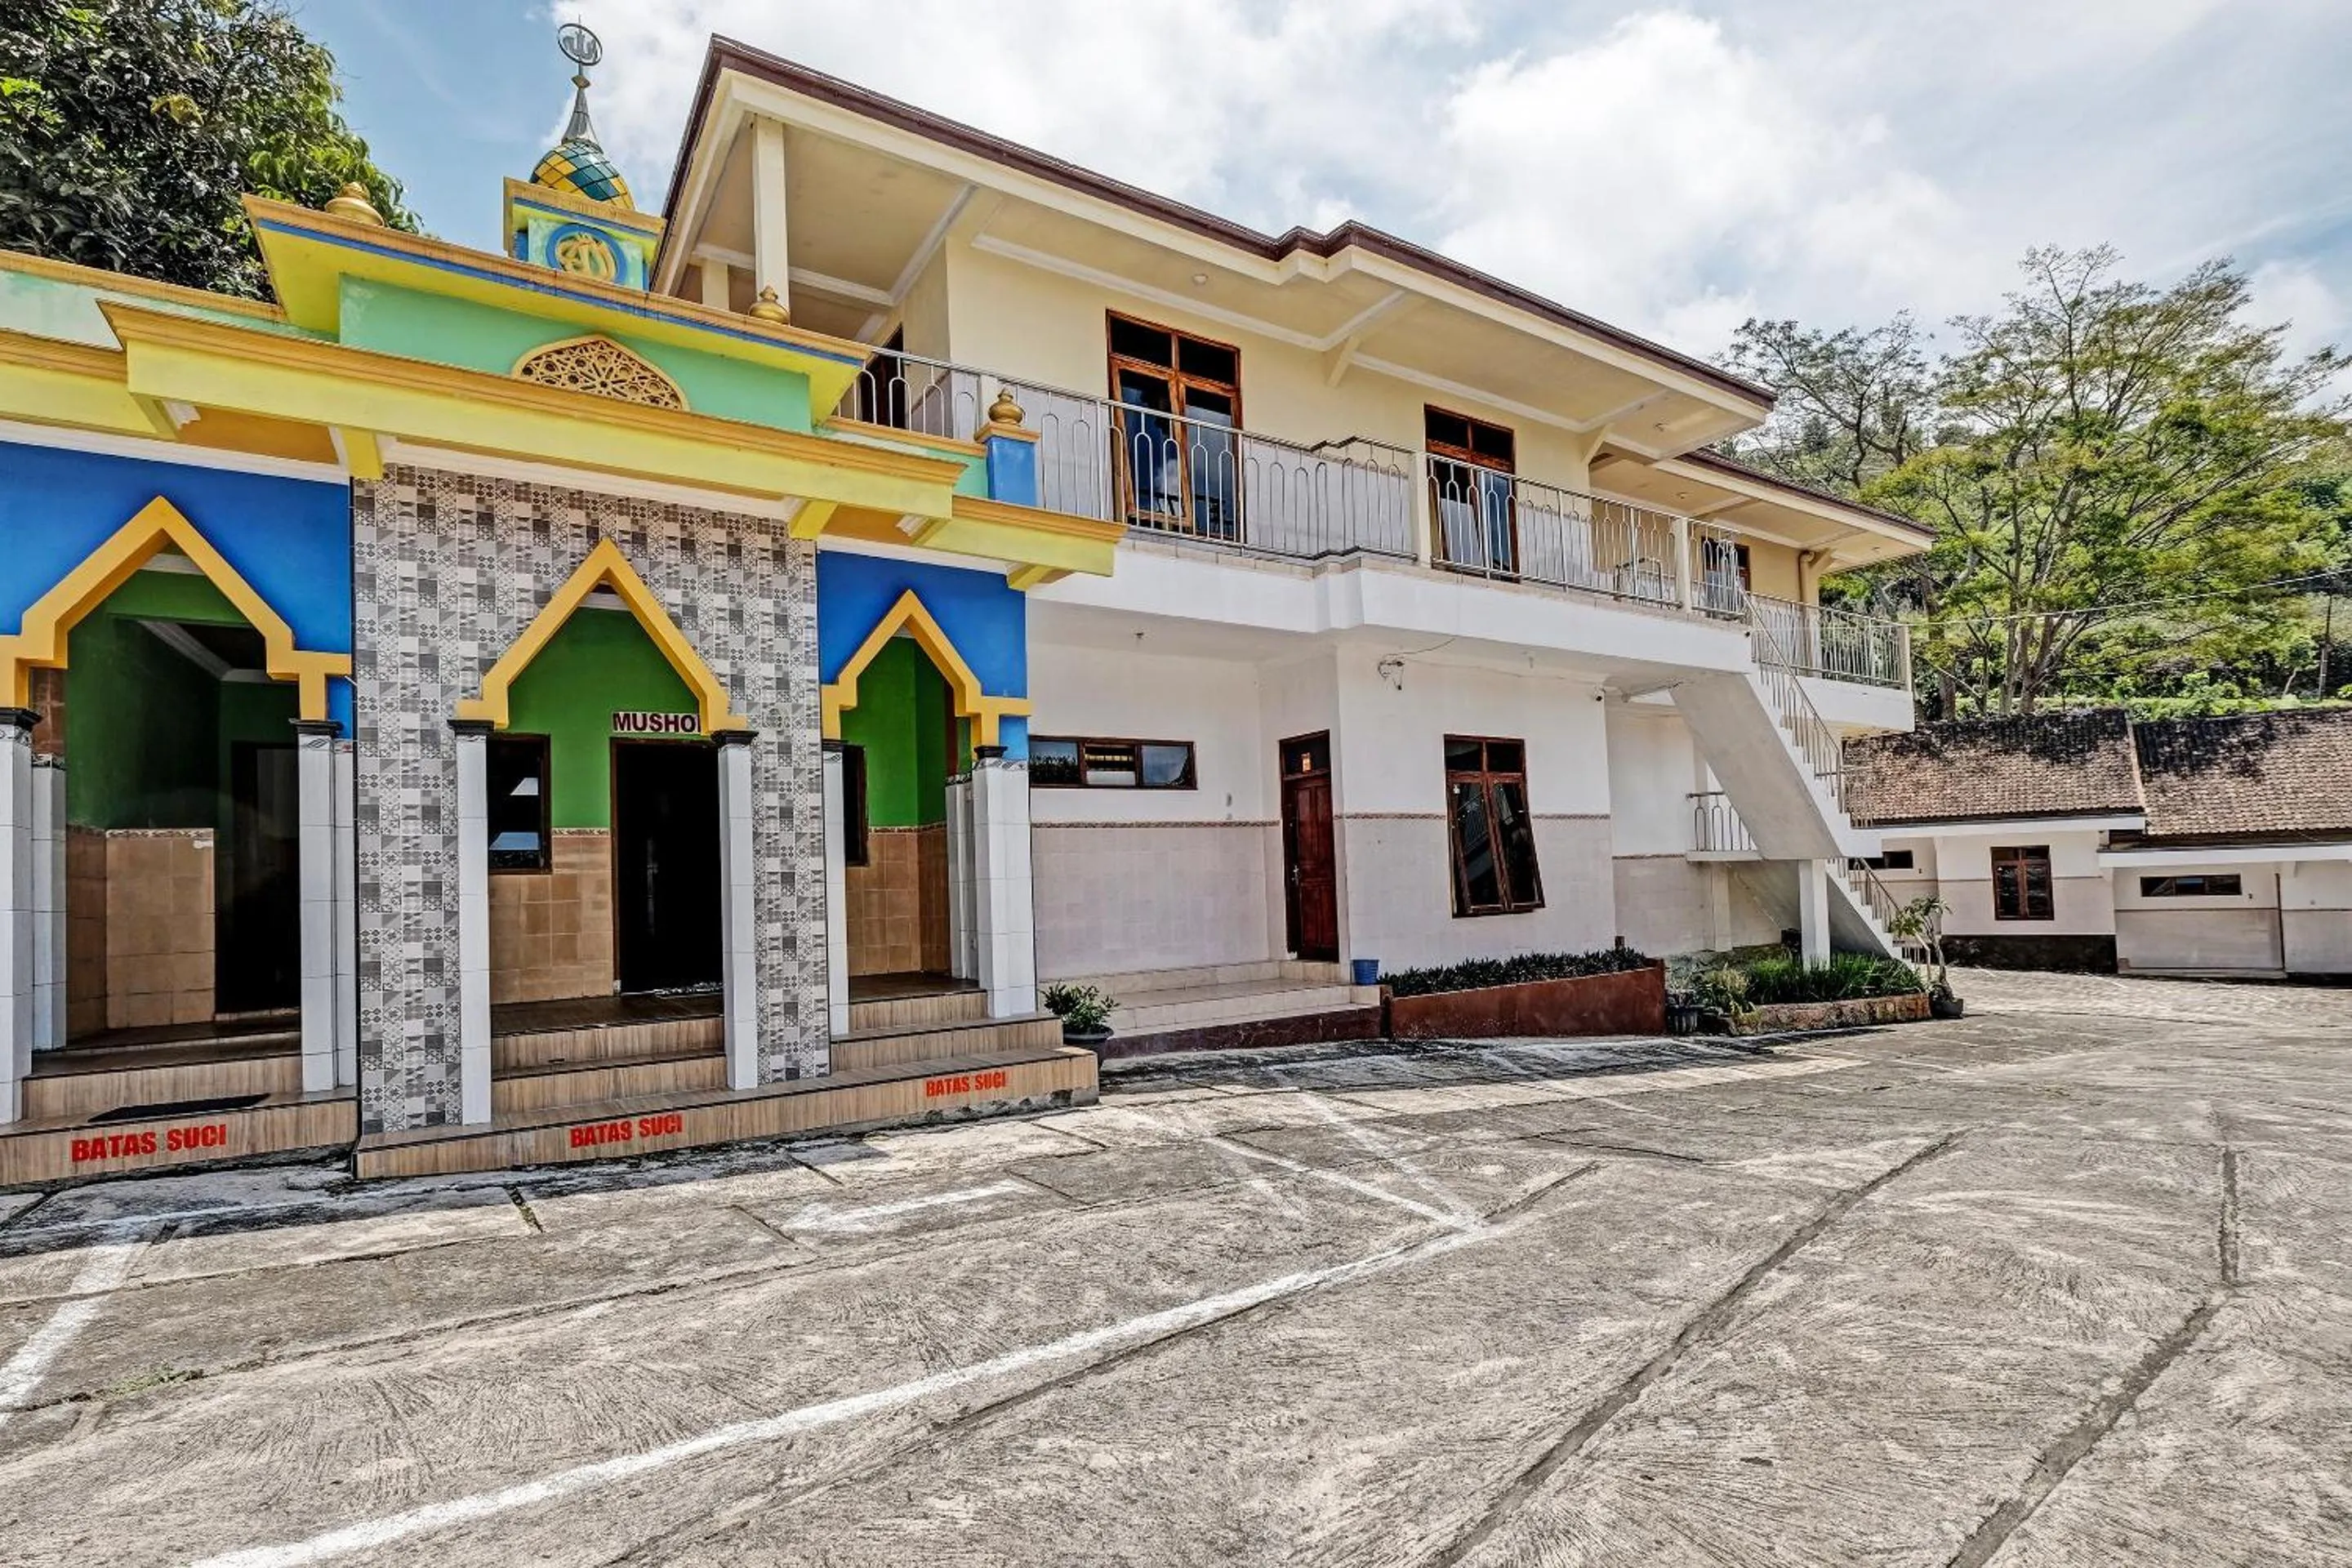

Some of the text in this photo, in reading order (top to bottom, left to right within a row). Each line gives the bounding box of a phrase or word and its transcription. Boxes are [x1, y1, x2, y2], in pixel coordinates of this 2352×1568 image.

[926, 1071, 1006, 1098] BATAS SUCI
[71, 1124, 226, 1161] BATAS SUCI
[570, 1113, 683, 1148] BATAS SUCI
